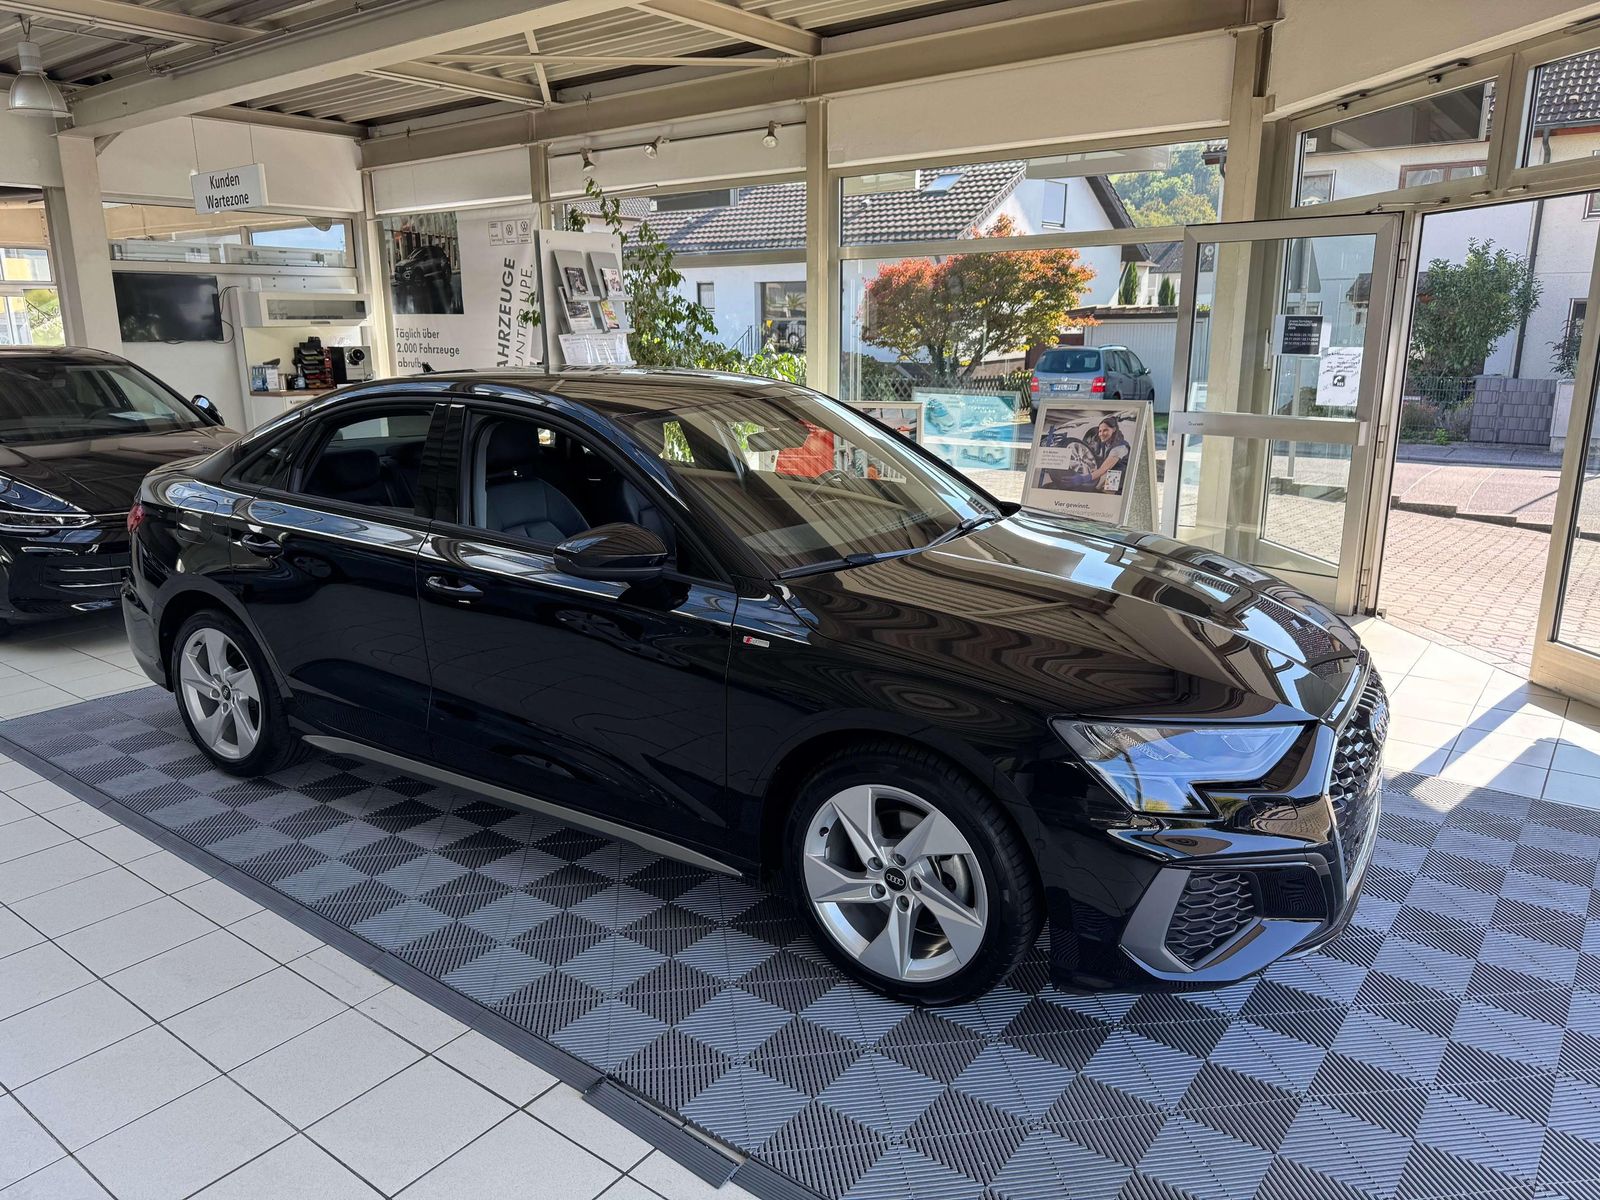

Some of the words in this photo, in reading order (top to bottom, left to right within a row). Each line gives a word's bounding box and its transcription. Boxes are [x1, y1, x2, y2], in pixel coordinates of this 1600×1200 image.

[209, 172, 240, 190] Kunden
[205, 193, 249, 209] Wartezone
[395, 328, 420, 340] Täglich
[422, 328, 440, 339] über
[396, 342, 418, 353] 2.000
[419, 343, 460, 357] Fahrzeuge
[398, 357, 428, 368] abrufb
